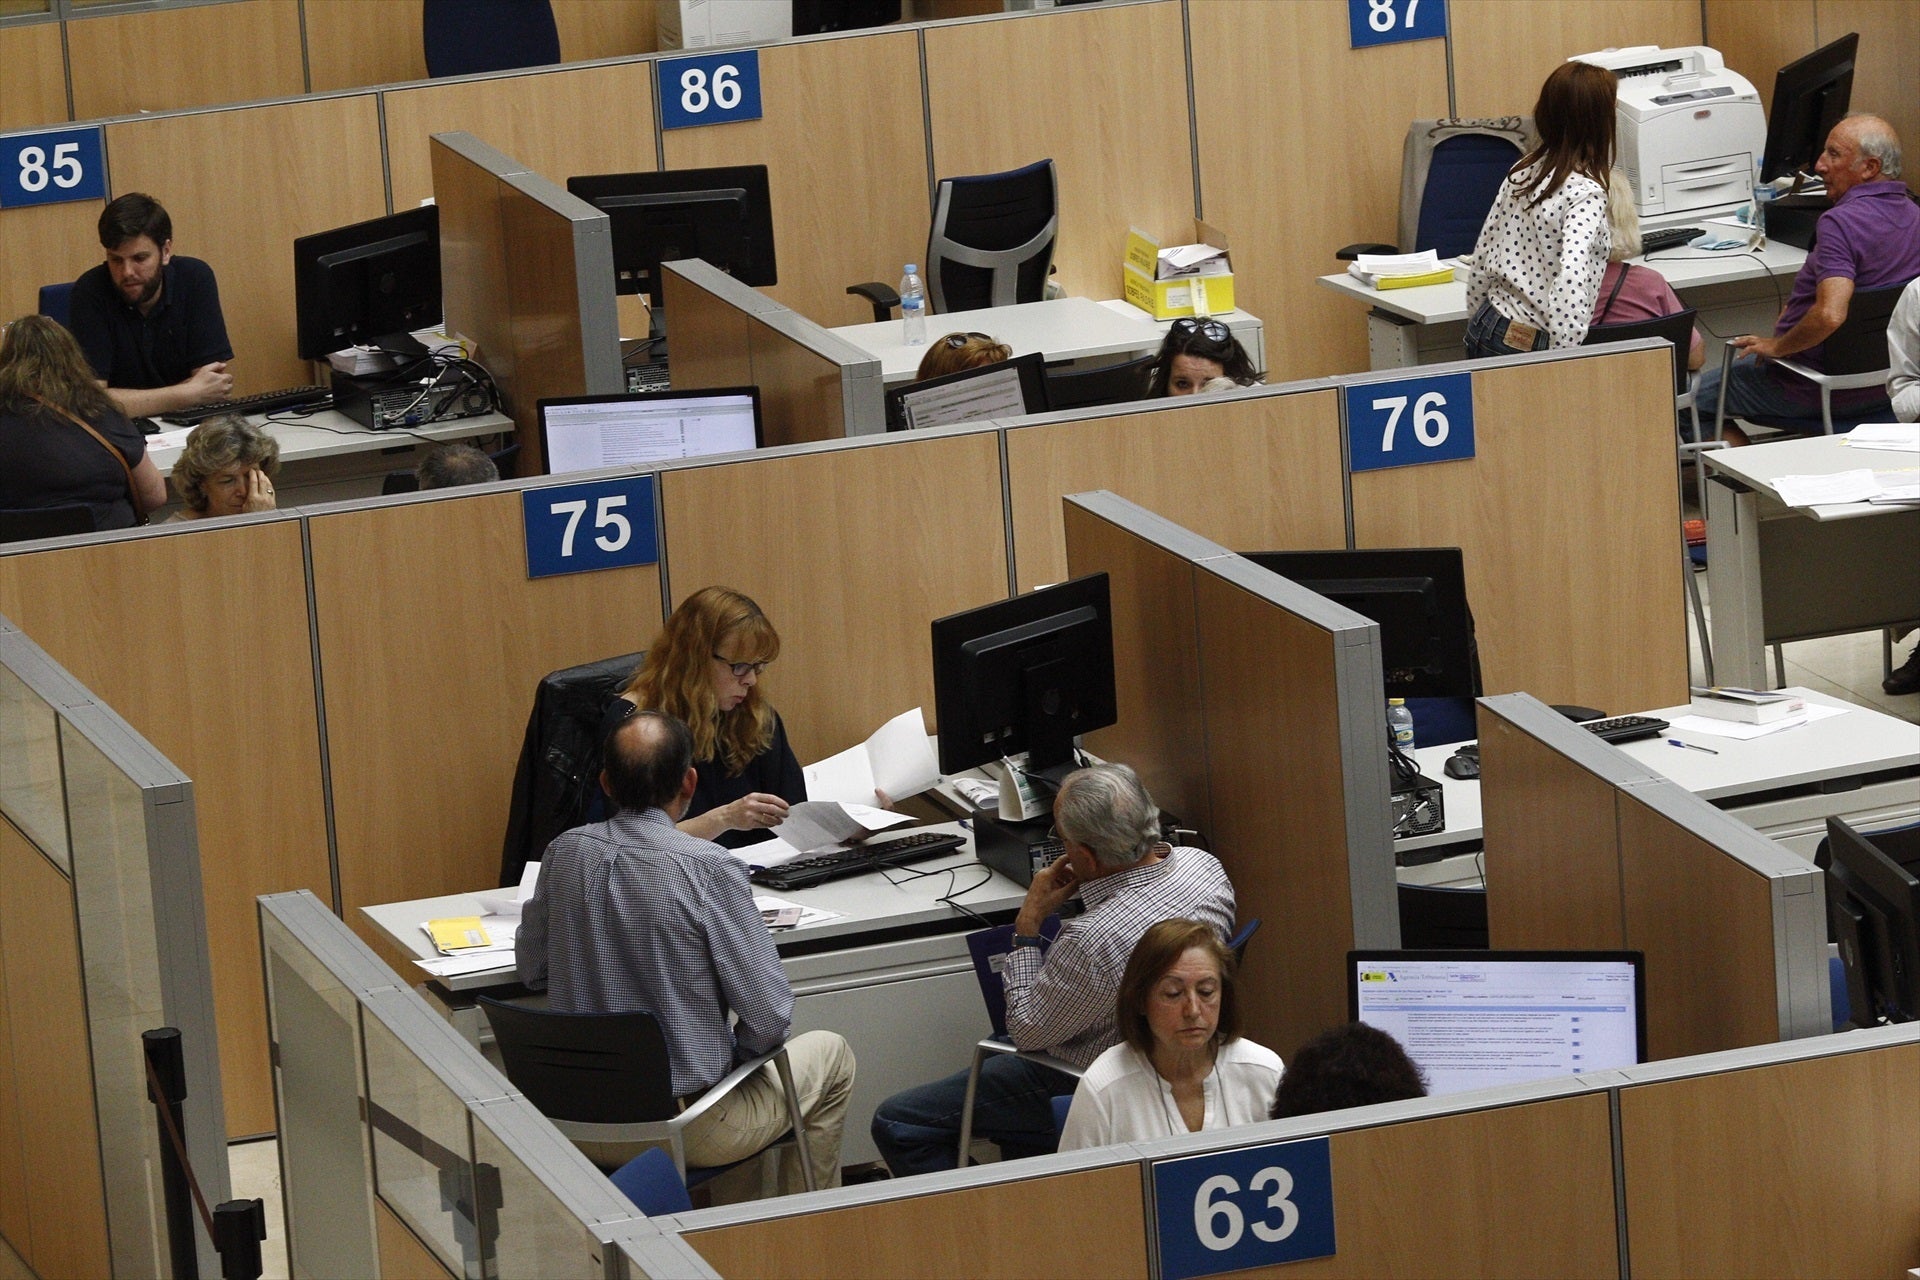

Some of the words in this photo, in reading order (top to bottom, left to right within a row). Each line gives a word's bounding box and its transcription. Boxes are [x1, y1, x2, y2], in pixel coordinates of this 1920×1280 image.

[1368, 0, 1419, 32] 87
[680, 64, 742, 113] 86
[18, 142, 83, 192] 85
[1372, 391, 1450, 452] 76
[550, 495, 631, 557] 75
[1194, 1166, 1299, 1251] 63
